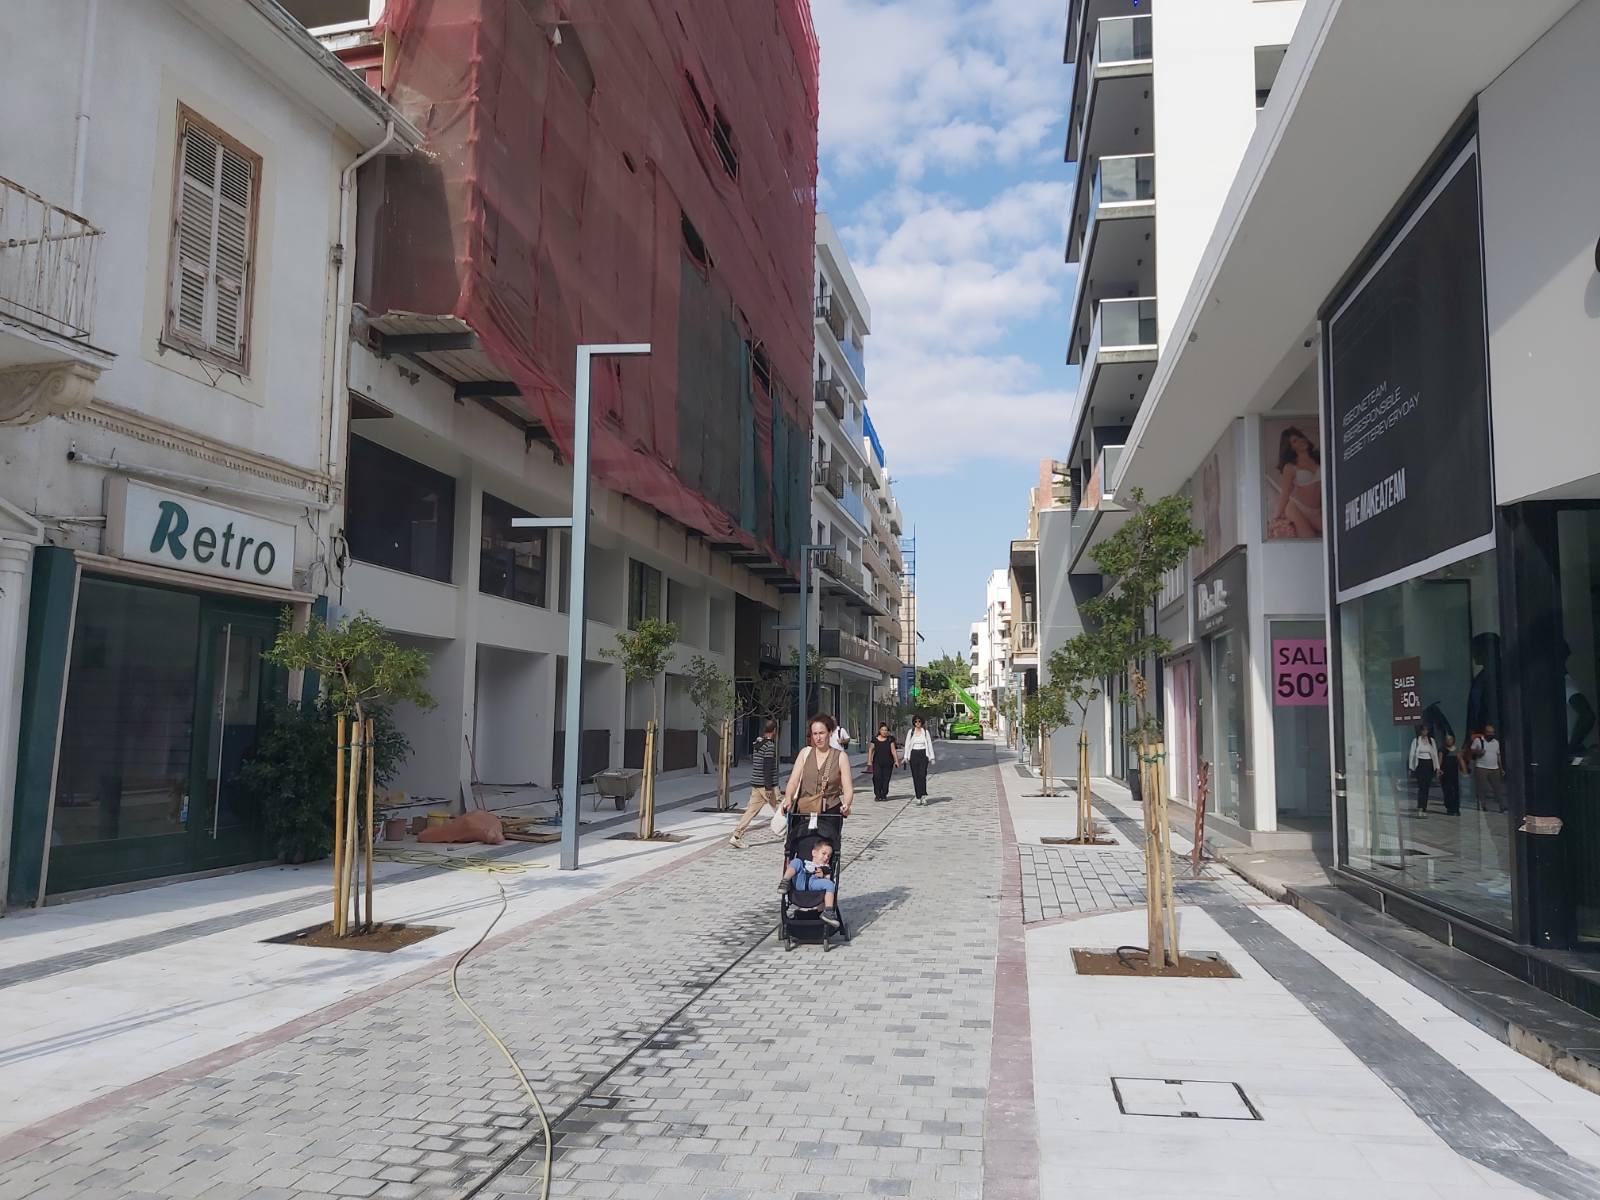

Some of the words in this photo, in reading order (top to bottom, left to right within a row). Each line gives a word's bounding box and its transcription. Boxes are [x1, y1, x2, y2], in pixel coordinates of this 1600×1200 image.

[1345, 467, 1406, 531] #WEMAKEATEAM
[150, 500, 275, 575] Retro
[1394, 676, 1415, 688] SALES
